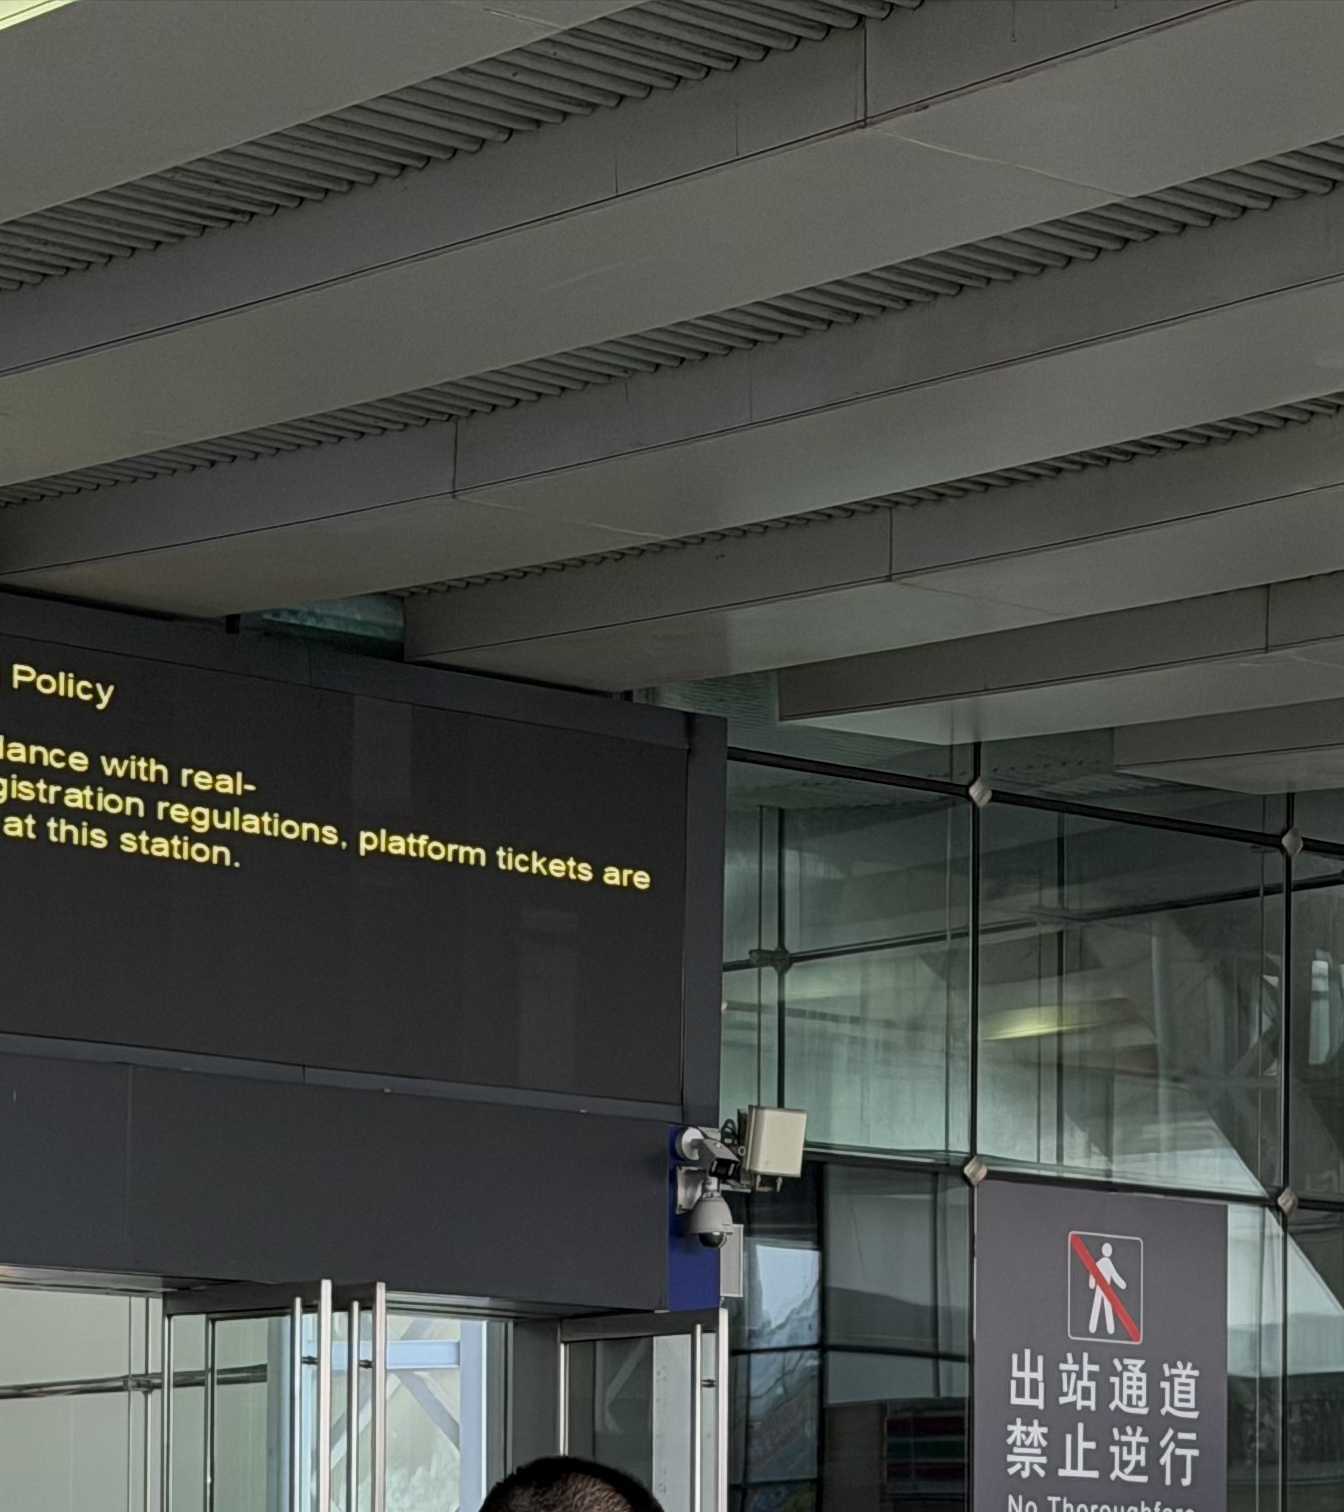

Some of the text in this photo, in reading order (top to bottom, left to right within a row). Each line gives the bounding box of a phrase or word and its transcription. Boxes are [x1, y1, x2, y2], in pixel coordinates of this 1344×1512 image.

[13, 664, 114, 709] Policy
[101, 755, 168, 784] with
[182, 769, 256, 795] real-
[3, 814, 36, 839] at
[47, 817, 108, 848] this
[120, 831, 239, 867] station.
[157, 801, 349, 852] regulations,
[360, 829, 485, 866] platform
[496, 847, 593, 881] tickets
[603, 867, 650, 889] are
[1011, 1349, 1199, 1418] 出站通道
[1006, 1418, 1199, 1486] 禁止逆行
